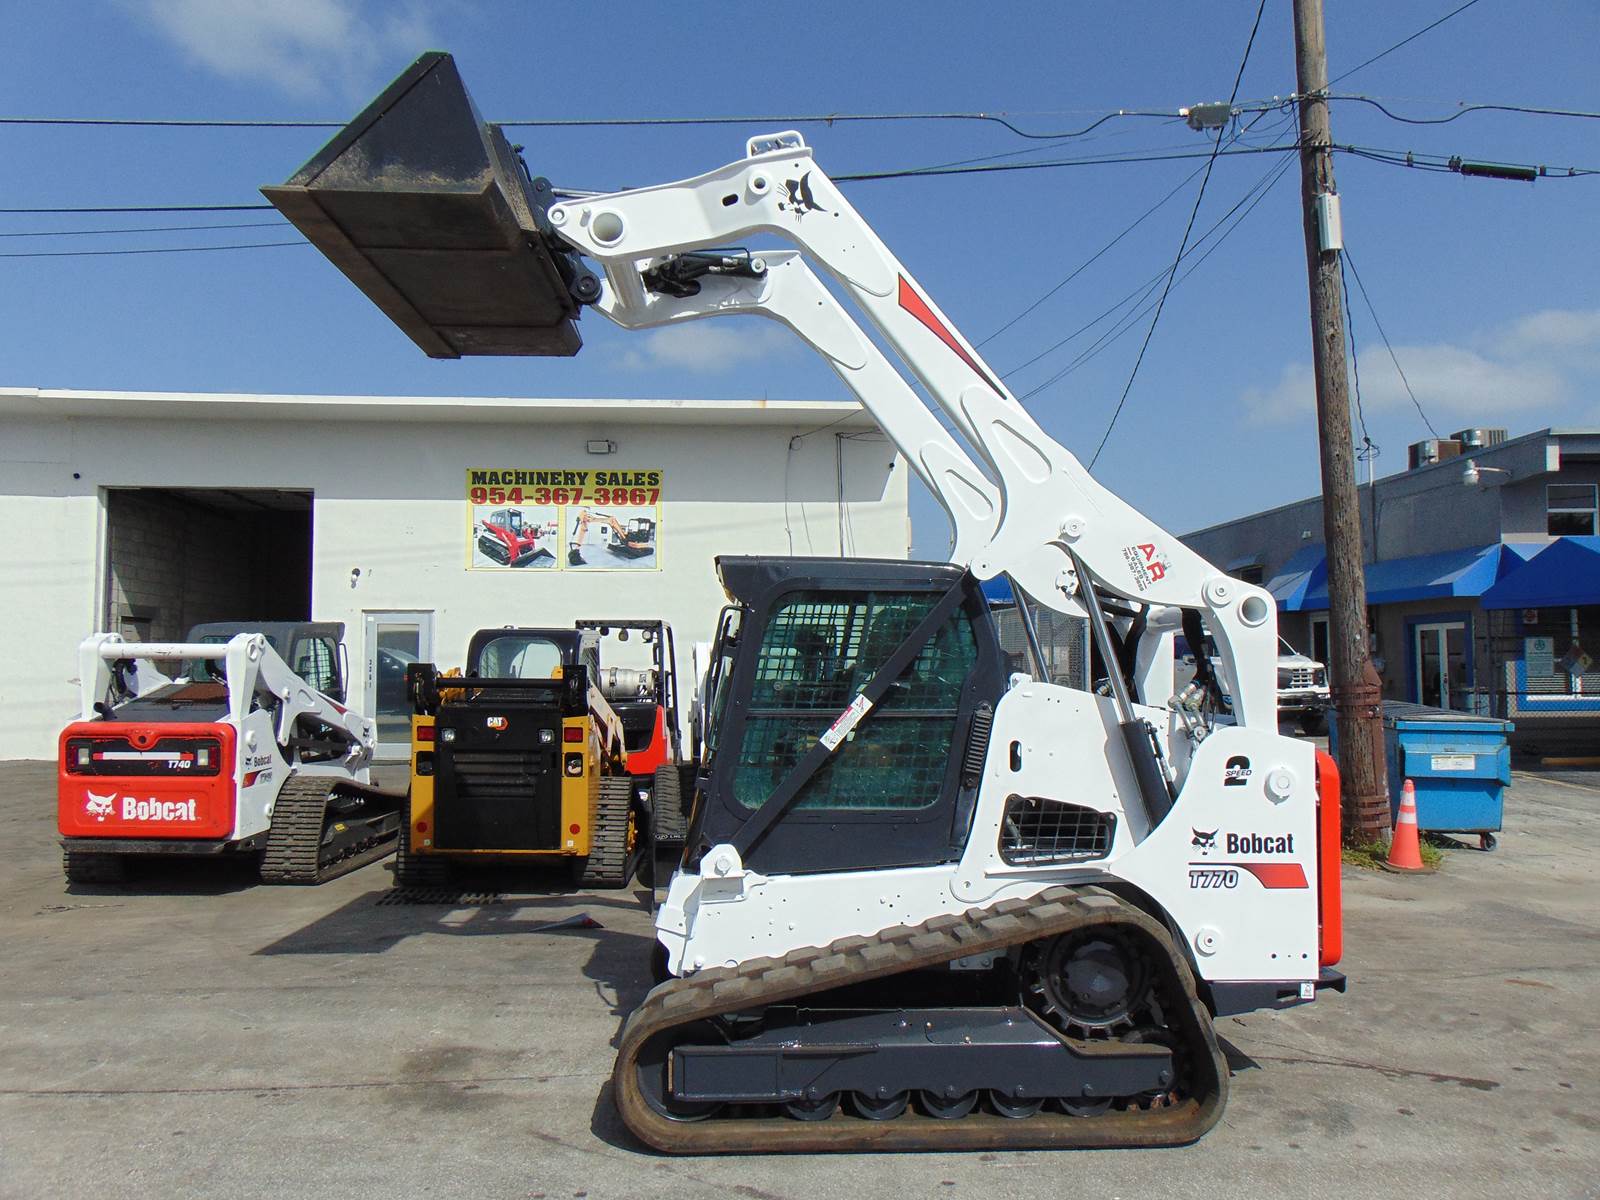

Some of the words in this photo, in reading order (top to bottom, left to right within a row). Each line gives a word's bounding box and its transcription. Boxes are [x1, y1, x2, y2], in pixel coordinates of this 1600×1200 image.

[471, 471, 588, 486] MACHINERY
[595, 472, 660, 487] SALES
[470, 487, 660, 506] 954-367-3867
[487, 716, 502, 727] CAT
[168, 760, 191, 769] T740
[254, 754, 272, 767] Bobcat
[1224, 755, 1250, 787] 2
[1225, 768, 1252, 777] SPEED
[122, 797, 196, 821] Bobcat
[1226, 833, 1294, 854] Bobcat
[1188, 870, 1239, 889] T770
